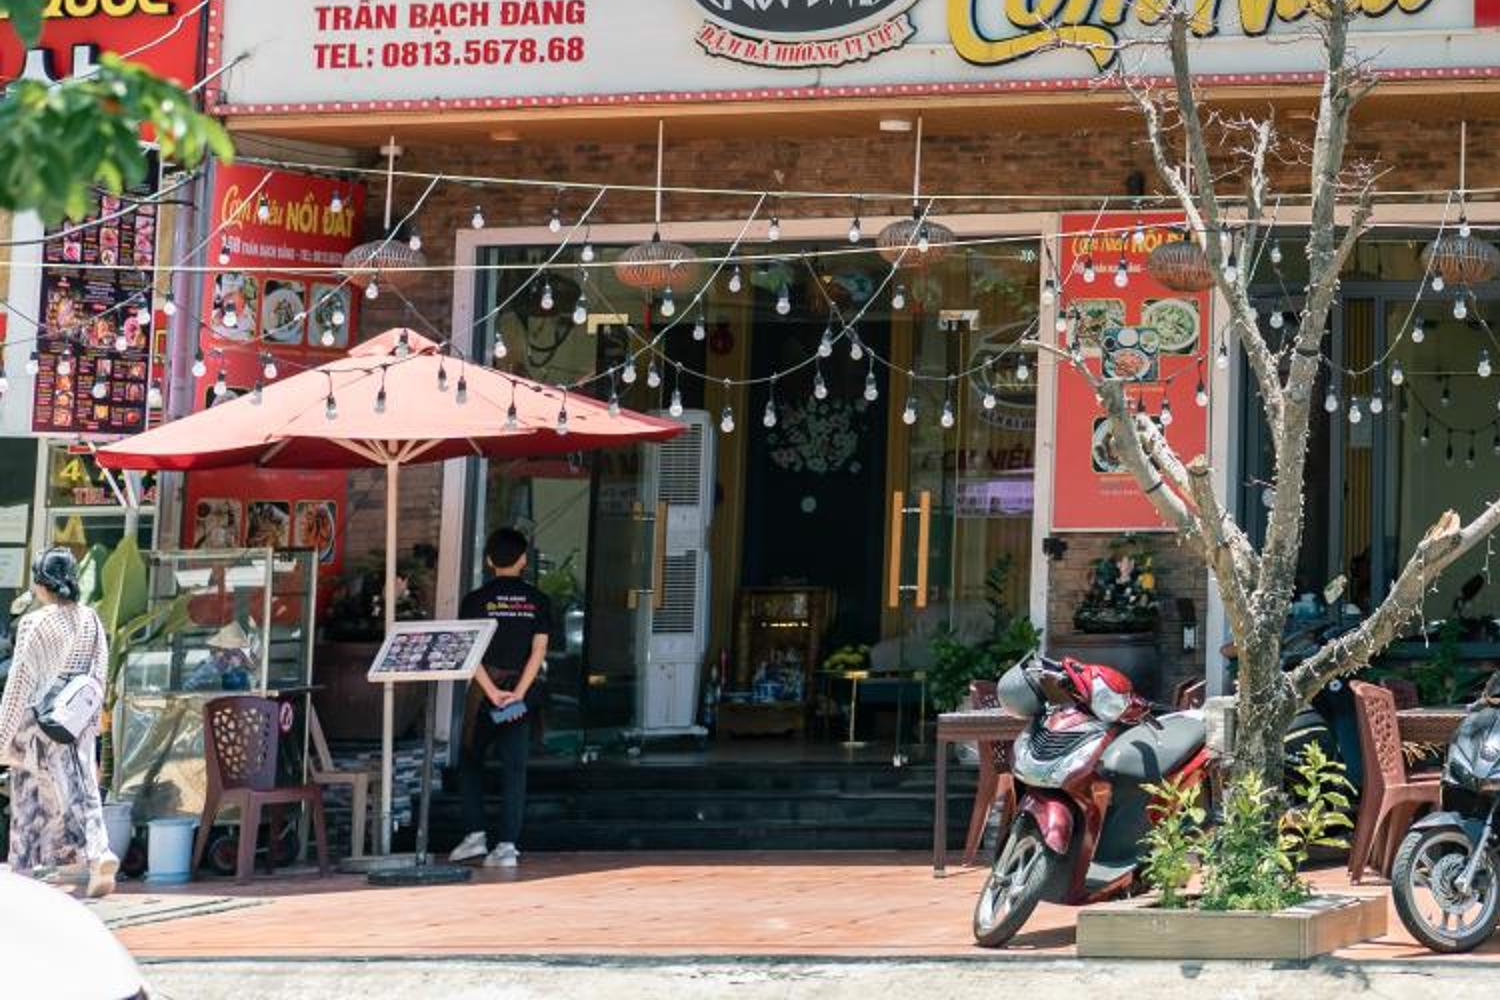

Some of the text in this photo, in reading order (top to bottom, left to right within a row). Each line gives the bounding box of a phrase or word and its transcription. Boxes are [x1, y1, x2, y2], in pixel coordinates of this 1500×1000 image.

[408, 2, 490, 35] BẠCH
[314, 36, 585, 69] TEL: 0813.5678.68
